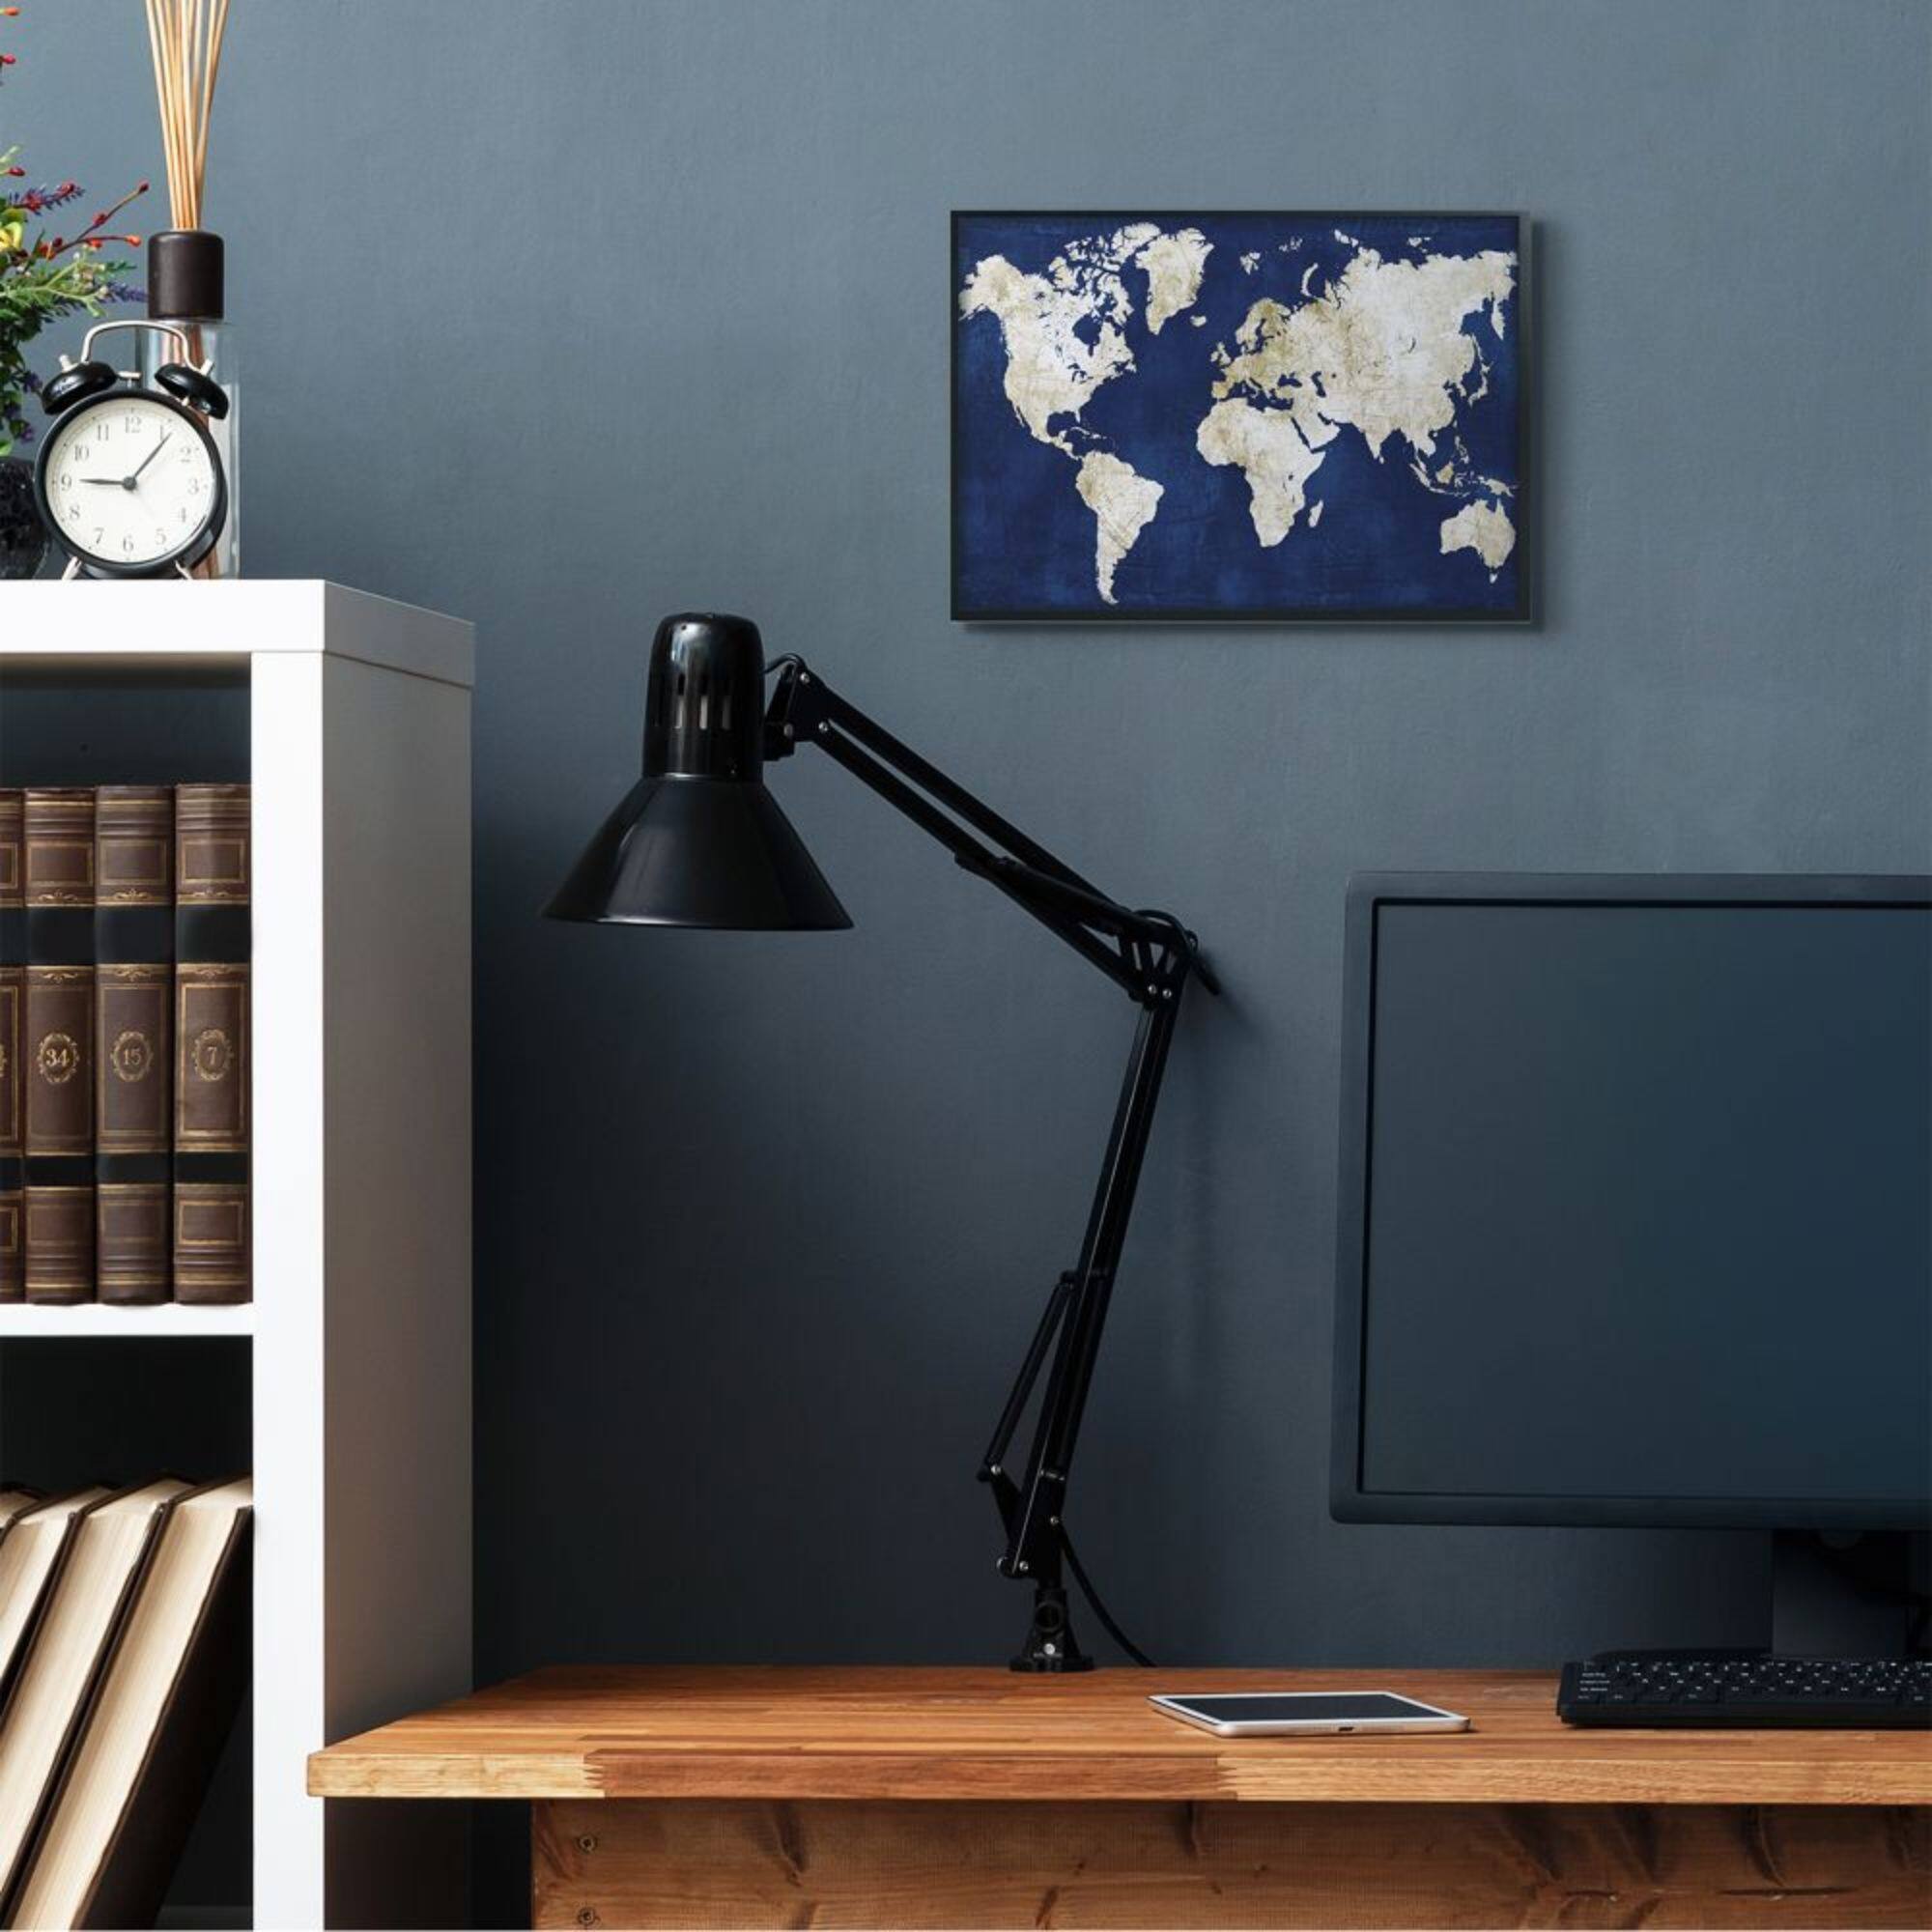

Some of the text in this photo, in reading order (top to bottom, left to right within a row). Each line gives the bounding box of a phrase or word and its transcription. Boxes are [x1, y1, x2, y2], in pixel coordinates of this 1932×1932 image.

[97, 425, 109, 441] 11
[125, 416, 142, 434] 12
[74, 445, 90, 461] 10
[180, 447, 192, 463] 2
[61, 474, 71, 491] 9
[187, 479, 199, 495] 3
[69, 505, 80, 520] 8
[176, 507, 186, 523] 4
[94, 528, 104, 544] 7
[123, 536, 134, 552] 6
[156, 528, 167, 545] 5
[45, 1049, 69, 1067] 34
[123, 1048, 142, 1066] 15
[207, 1046, 217, 1065] 7
